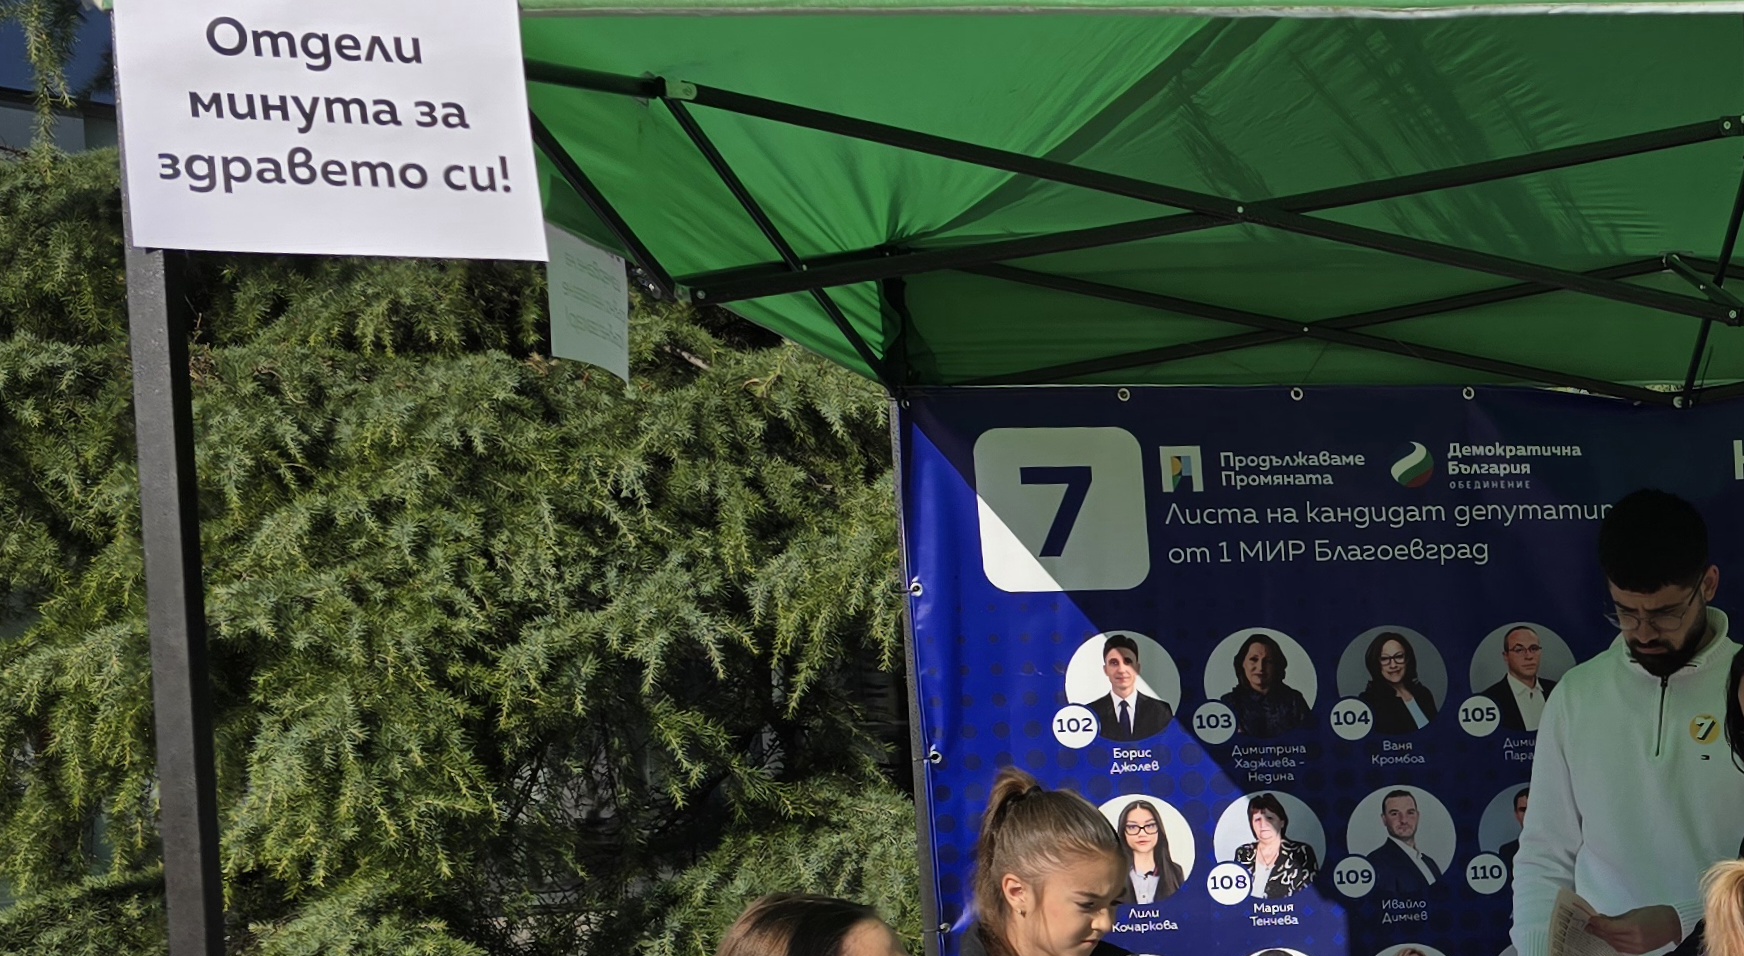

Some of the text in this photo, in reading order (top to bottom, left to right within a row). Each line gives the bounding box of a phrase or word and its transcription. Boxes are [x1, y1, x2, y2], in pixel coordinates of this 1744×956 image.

[206, 16, 422, 71] Отдели
[189, 91, 470, 133] минута за
[157, 147, 512, 194] здравето си!
[1447, 441, 1582, 459] Демократична
[1219, 451, 1365, 471] Продължаваме
[1448, 460, 1531, 477] България
[1221, 470, 1334, 490] Промяната
[1449, 480, 1531, 490] ОБЕДИНЕНИЕ
[1020, 466, 1093, 558] 7
[1165, 502, 1260, 525] Листа
[1267, 507, 1299, 523] на
[1306, 500, 1446, 528] кандидат
[1168, 538, 1489, 566] от 1 МИР Благоевград
[1196, 713, 1233, 730] 103
[1333, 710, 1370, 726] 104
[1461, 706, 1497, 723] 105
[1056, 717, 1094, 733] 102
[1112, 747, 1152, 761] Борис
[1231, 744, 1307, 758] Димитрина
[1382, 740, 1413, 752] Ваня
[1109, 760, 1160, 775] Джолев
[1234, 757, 1296, 772] Хаджиева
[1248, 771, 1295, 784] Недина
[1336, 869, 1373, 886] 109
[1470, 865, 1503, 881] 110
[1210, 875, 1248, 890] 108
[1128, 907, 1160, 919] Лили
[1253, 902, 1295, 916] Мария
[1381, 899, 1427, 911] Ивайло
[1249, 914, 1299, 927] Тенчева
[1381, 910, 1428, 924] Димчев
[1112, 919, 1179, 934] Кочаркова
